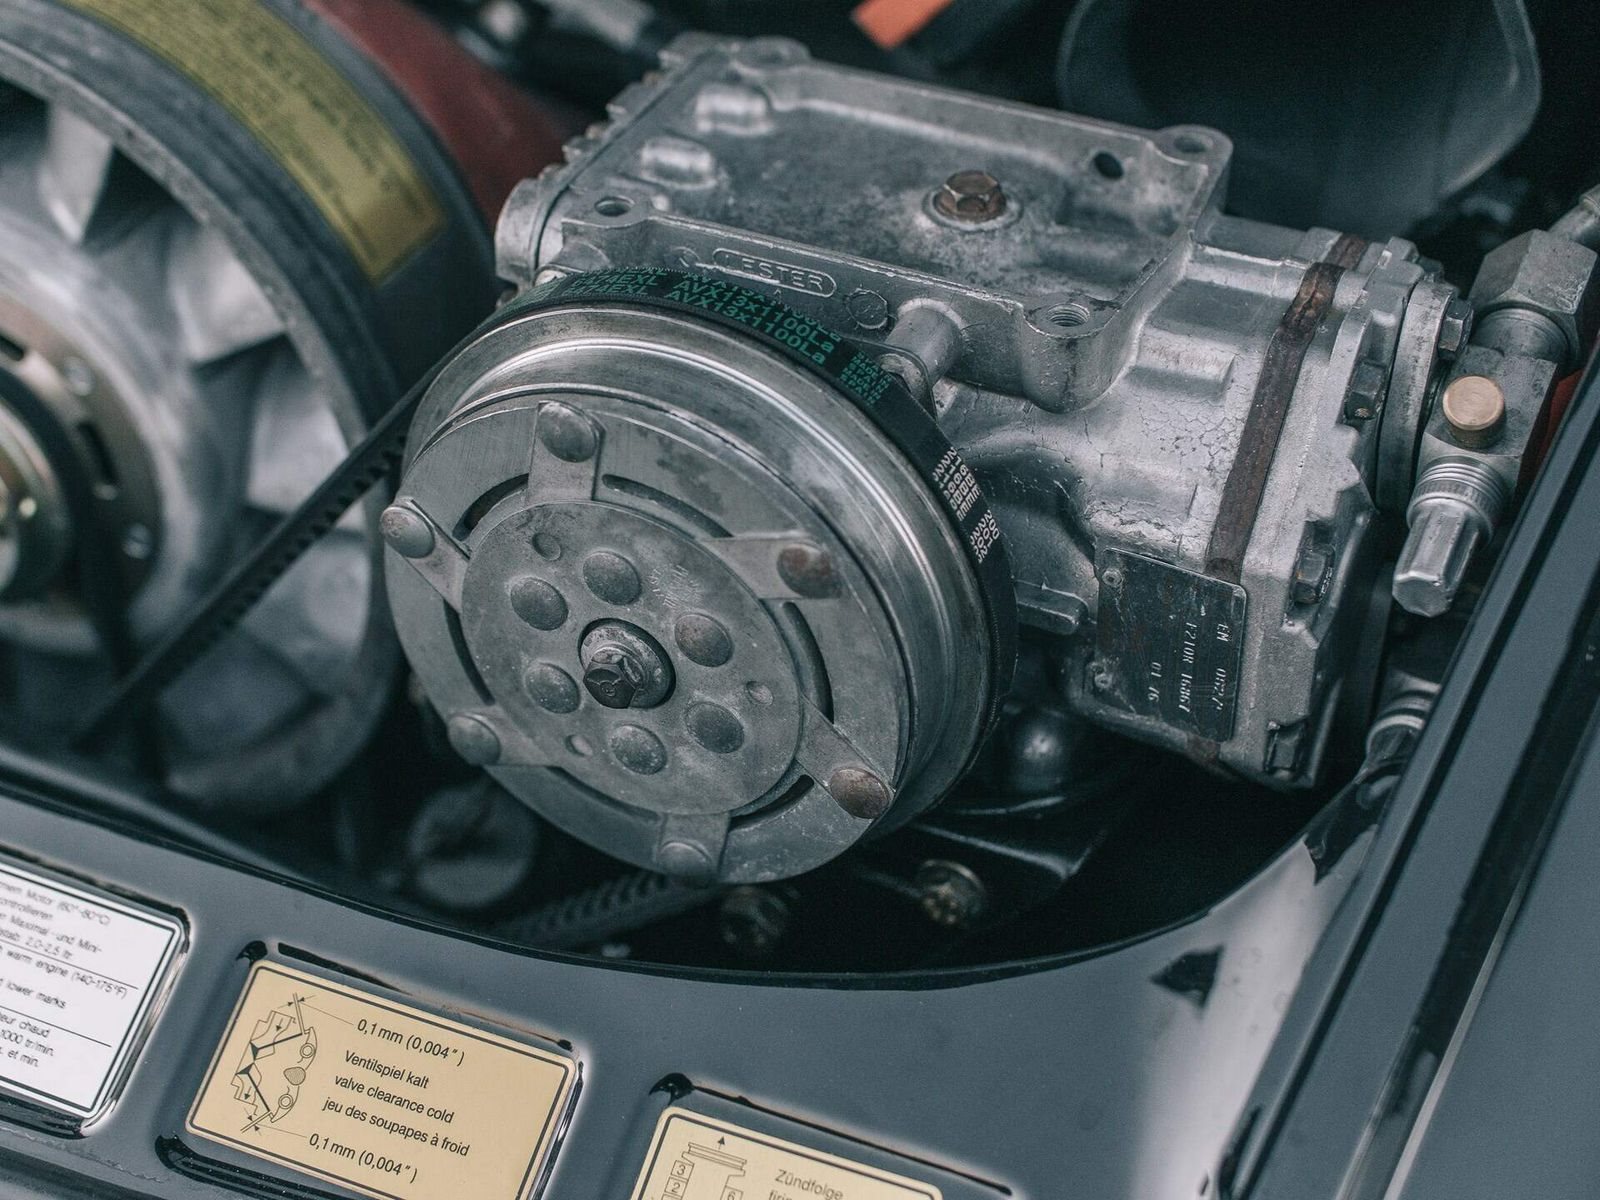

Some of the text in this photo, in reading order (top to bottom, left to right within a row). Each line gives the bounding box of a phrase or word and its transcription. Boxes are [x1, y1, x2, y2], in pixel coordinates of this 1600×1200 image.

[665, 290, 827, 365] AVX13x1100La
[673, 280, 835, 353] AVX13x1100La
[935, 464, 988, 559] 216BE 202
[941, 455, 993, 548] 216BE 201
[36, 960, 68, 977] engine
[36, 991, 66, 1009] marks
[19, 1021, 51, 1038] chaud
[345, 1050, 429, 1089] Ventilspiel kalt
[335, 1076, 455, 1123] valve clearance cold
[322, 1097, 470, 1156] jeu des soupapes à froid
[671, 1182, 681, 1193] 2
[676, 1164, 686, 1176] 3
